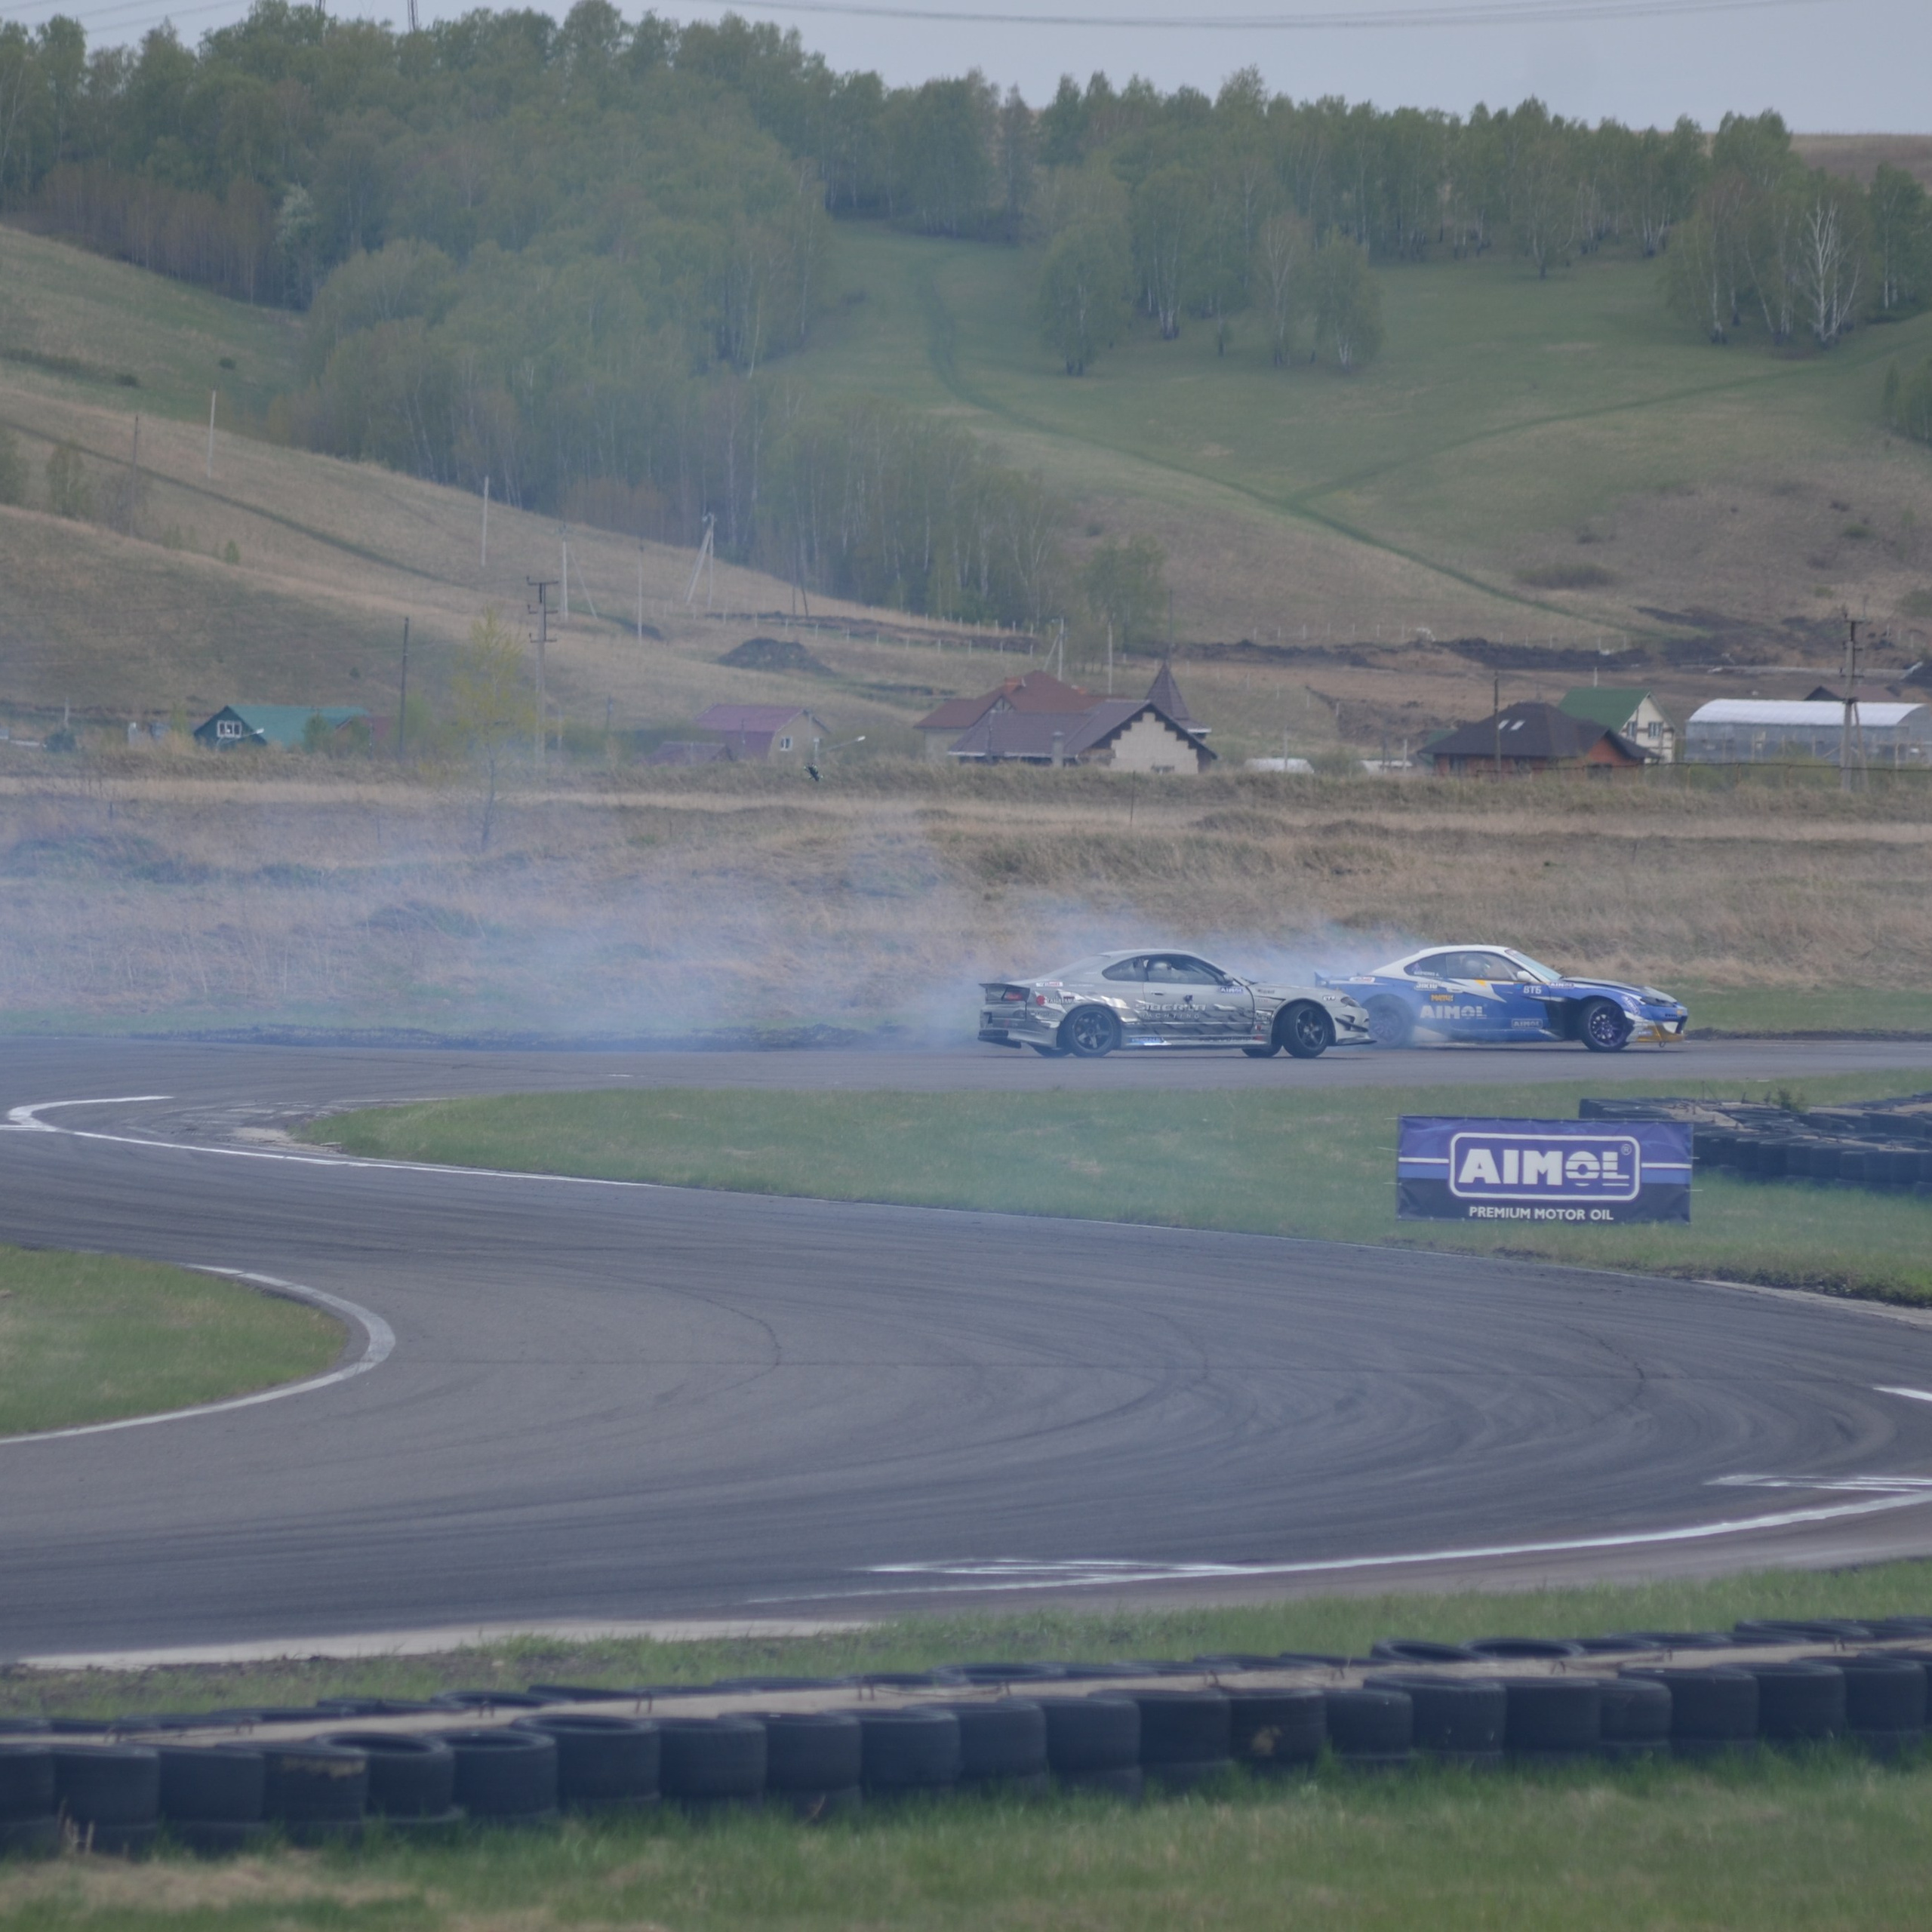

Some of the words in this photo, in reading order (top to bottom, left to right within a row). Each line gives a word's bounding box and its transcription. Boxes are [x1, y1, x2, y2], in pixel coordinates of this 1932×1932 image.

[1523, 986, 1542, 994] ВТБ
[1420, 1005, 1487, 1020] AIMOL
[1458, 1149, 1630, 1187] AIMOL
[1469, 1206, 1531, 1220] PREMIUM
[1534, 1208, 1586, 1220] MOTOR
[1591, 1209, 1614, 1221] OIL
